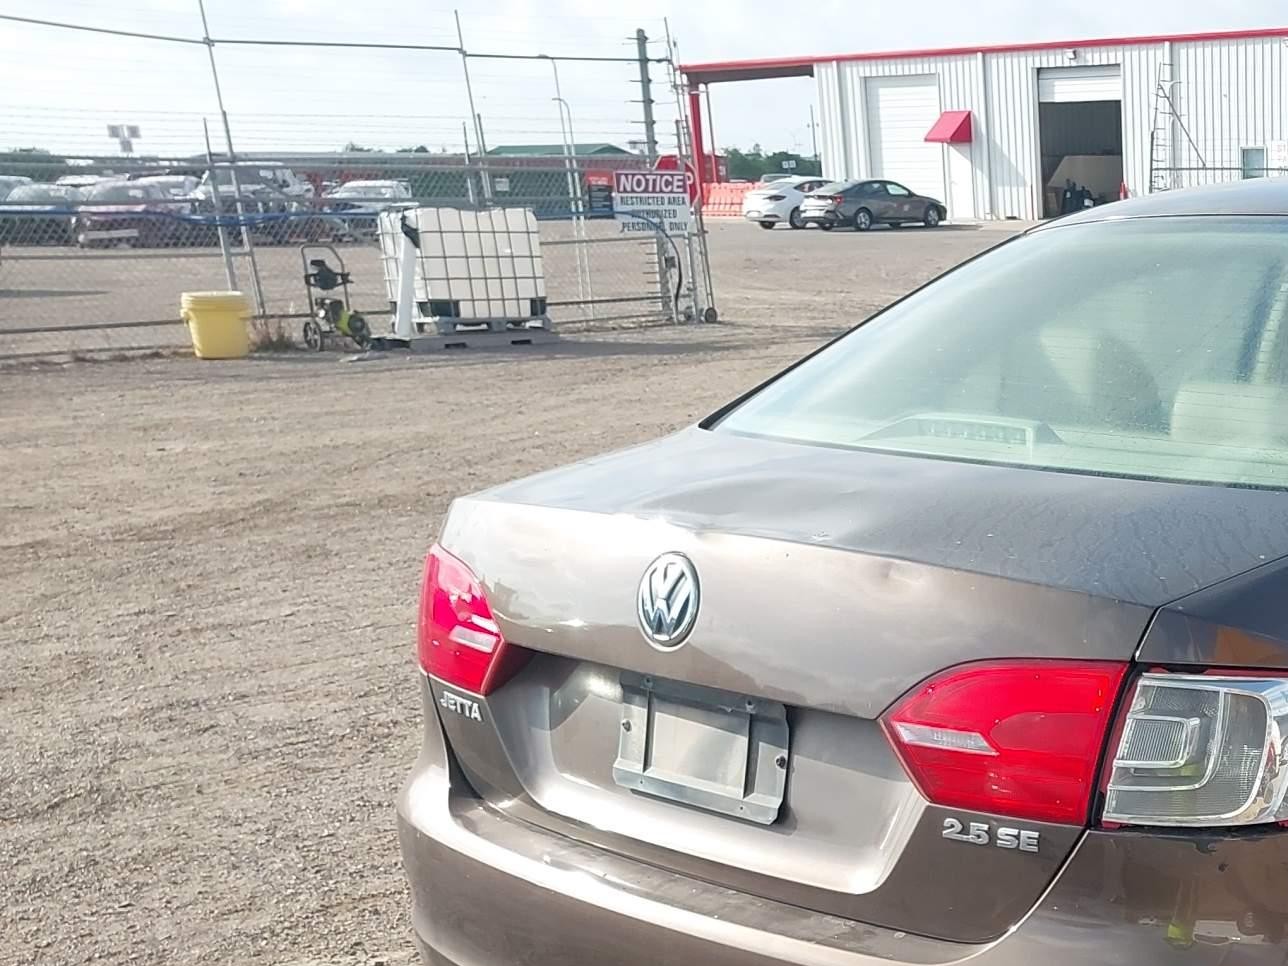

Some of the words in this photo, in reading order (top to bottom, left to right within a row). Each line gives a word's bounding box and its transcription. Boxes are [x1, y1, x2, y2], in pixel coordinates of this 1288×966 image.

[619, 174, 684, 193] NOTICE
[620, 195, 666, 206] RESTRICTED
[667, 195, 686, 206] AREA
[631, 209, 677, 219] THORIZED
[622, 221, 666, 232] PERSON
[669, 221, 688, 232] ONLY
[440, 691, 482, 721] JETTA
[942, 817, 989, 845] 2.5
[996, 827, 1040, 853] SE
